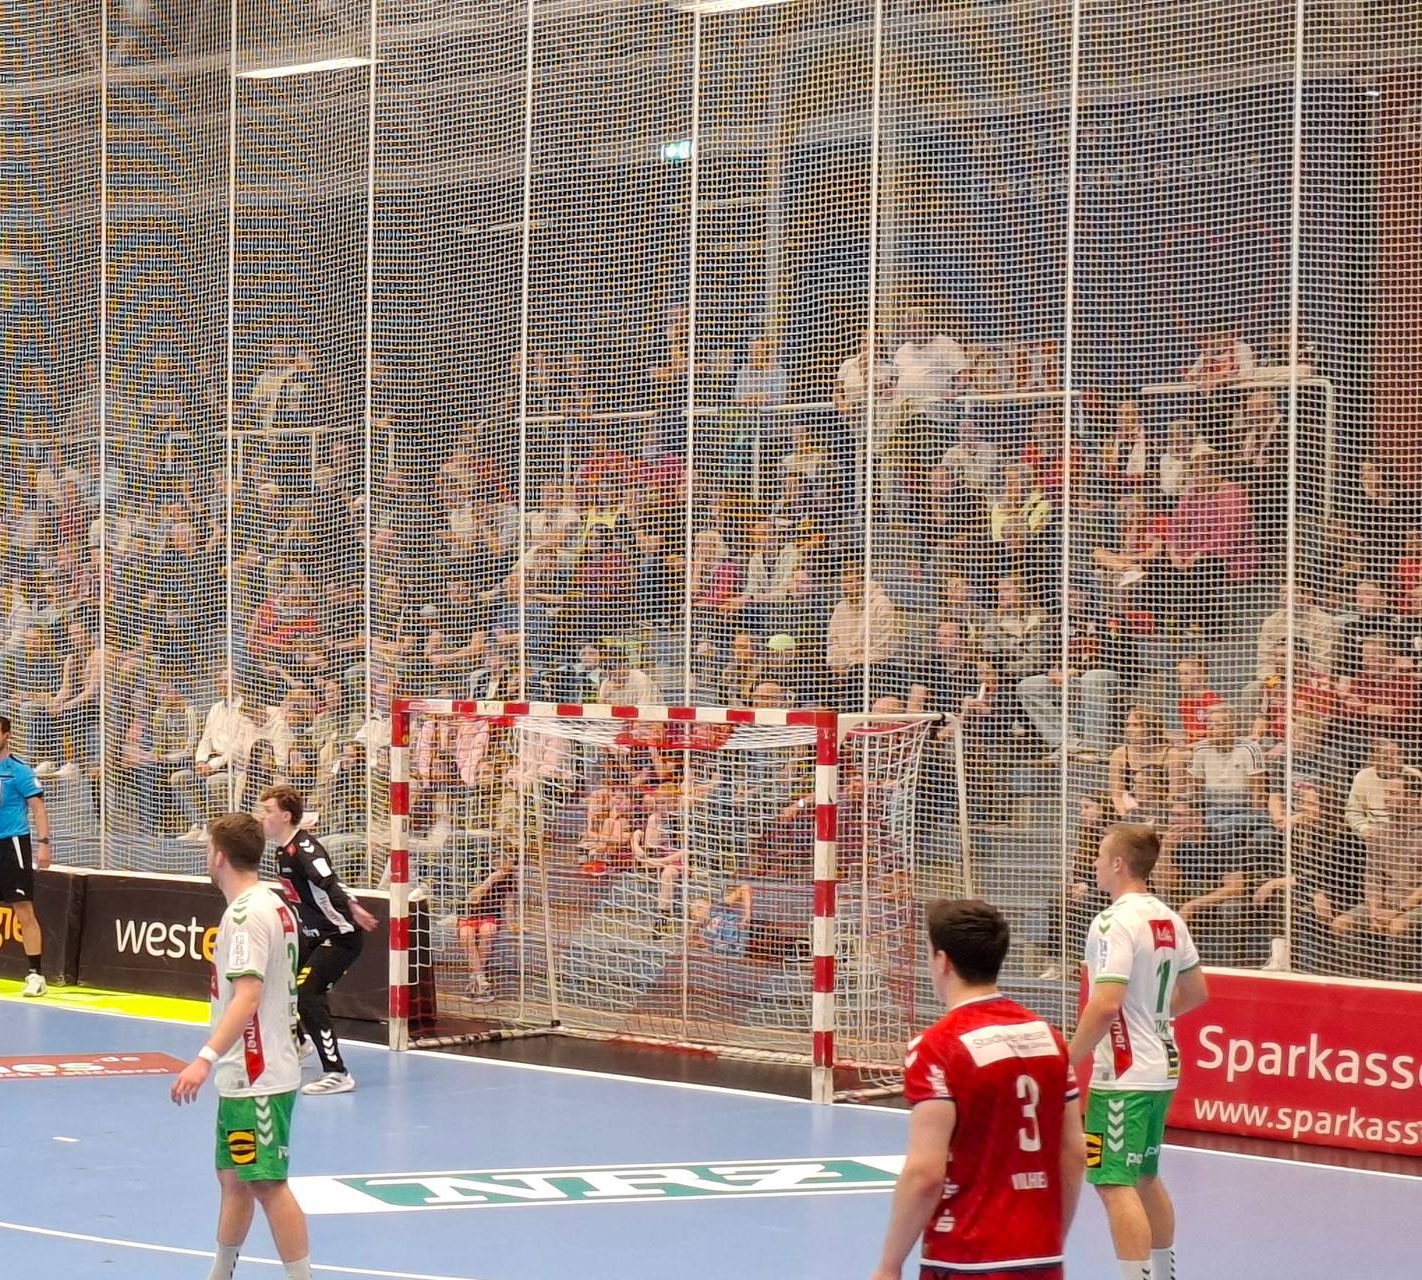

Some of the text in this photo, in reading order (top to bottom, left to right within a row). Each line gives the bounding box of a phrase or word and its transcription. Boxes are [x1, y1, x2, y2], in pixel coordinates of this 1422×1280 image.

[1196, 1024, 1422, 1090] Sparkass
[1015, 1074, 1042, 1152] 3
[1194, 1097, 1422, 1146] www.sparkass
[365, 1162, 844, 1204] NRZ
